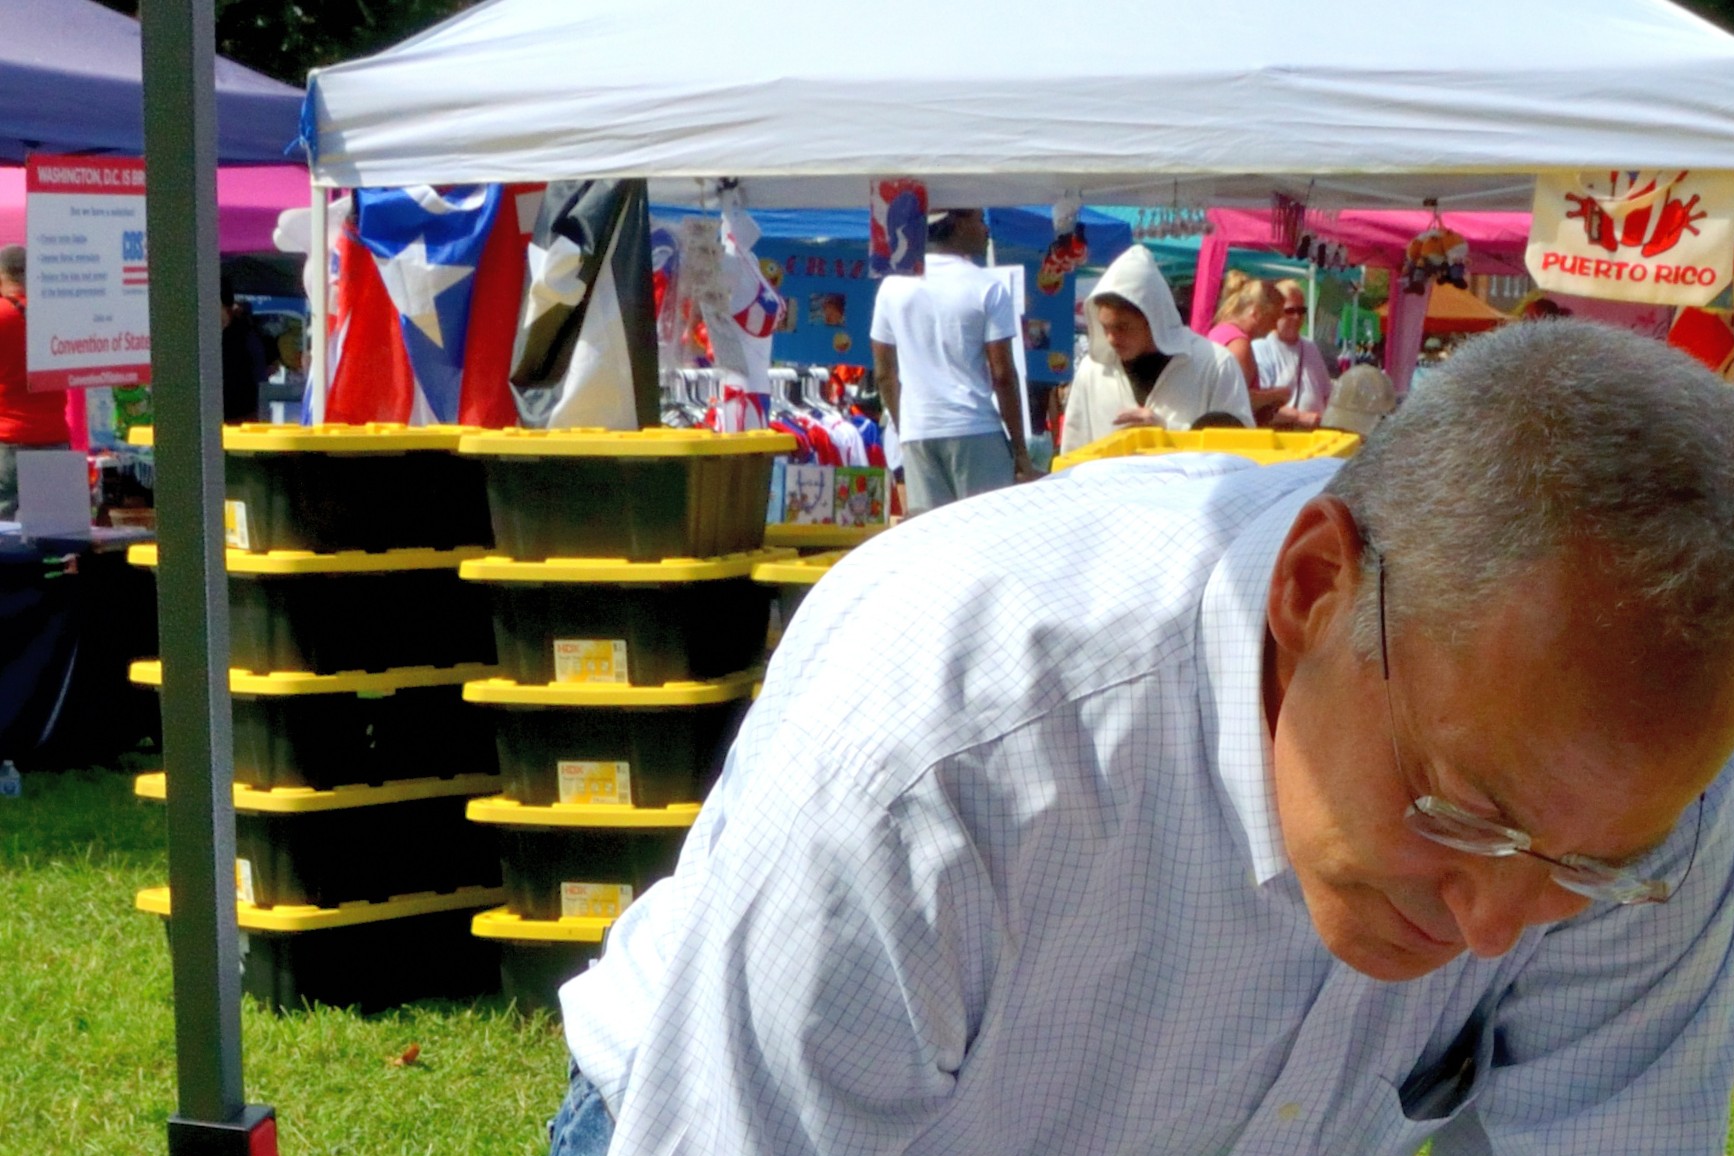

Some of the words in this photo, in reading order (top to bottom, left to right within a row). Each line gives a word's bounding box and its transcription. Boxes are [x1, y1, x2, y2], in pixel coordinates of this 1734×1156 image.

[1541, 252, 1648, 282] PUERTO
[1655, 265, 1717, 288] RICO
[51, 335, 109, 355] Convention
[111, 333, 122, 351] of
